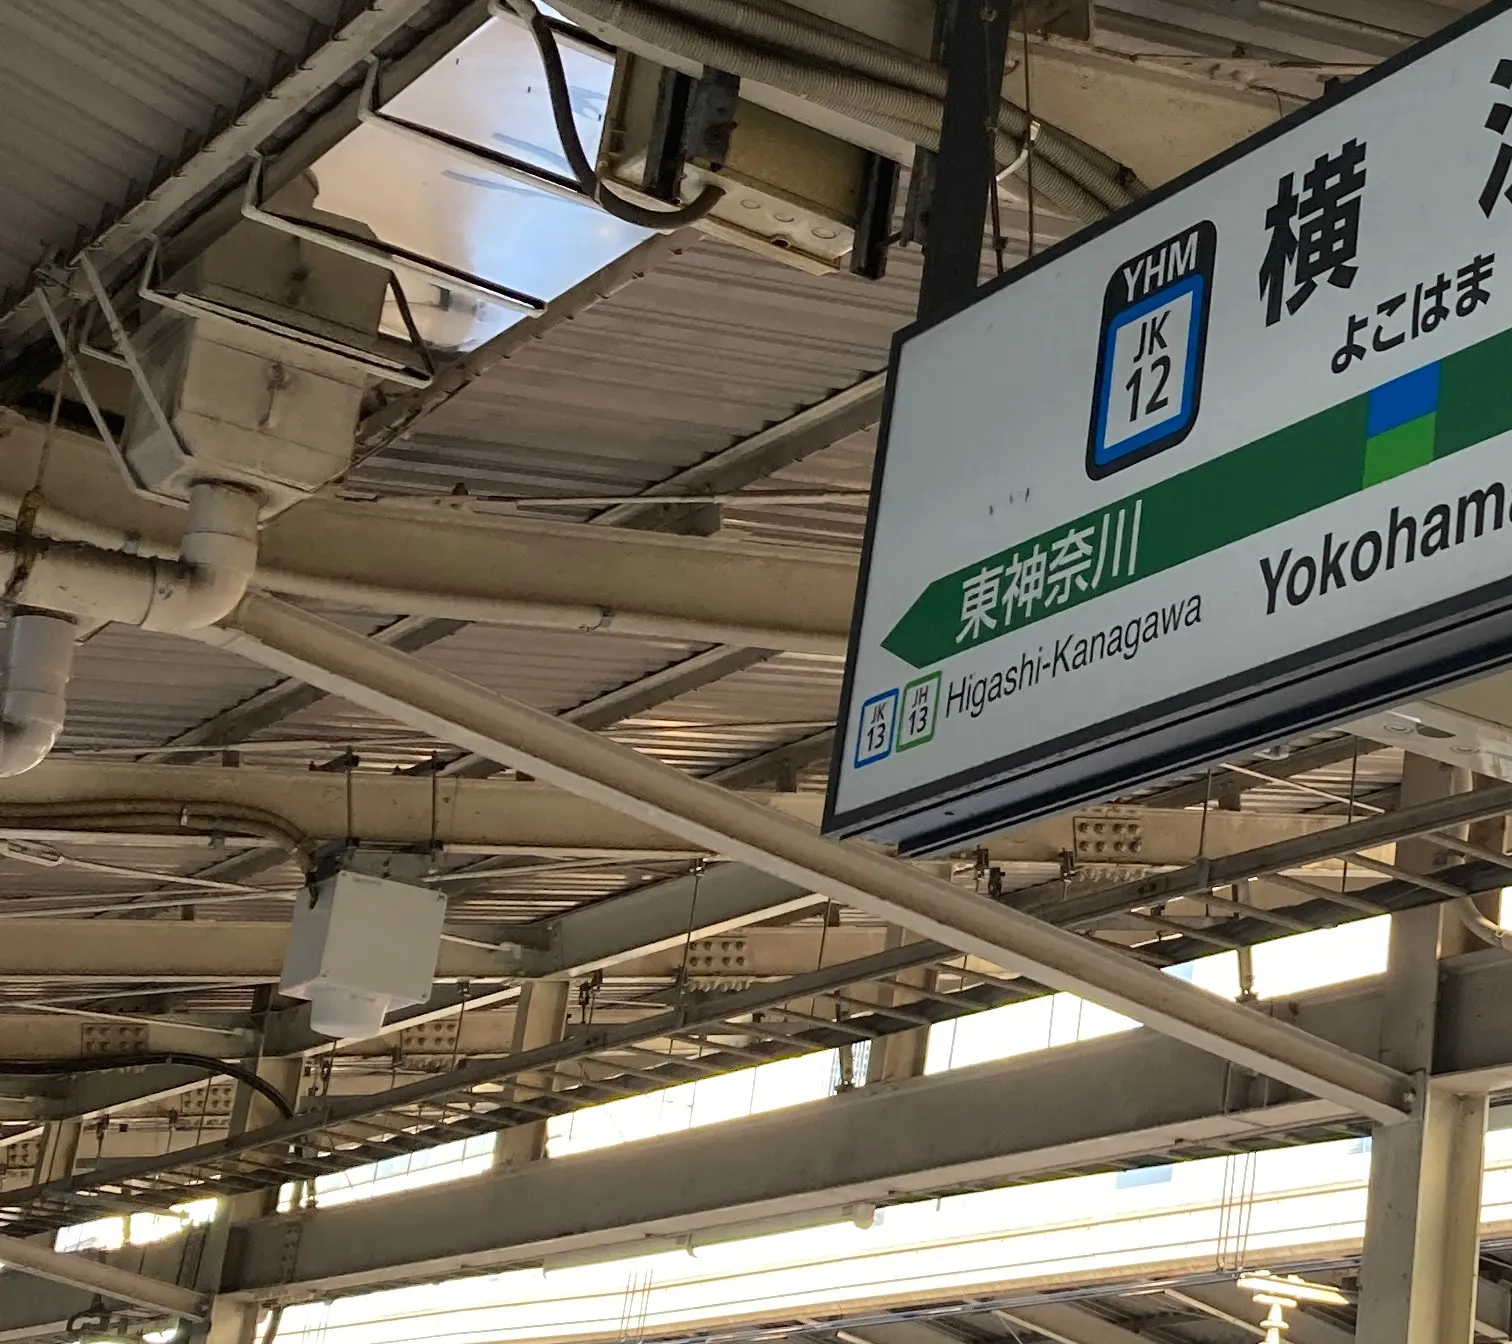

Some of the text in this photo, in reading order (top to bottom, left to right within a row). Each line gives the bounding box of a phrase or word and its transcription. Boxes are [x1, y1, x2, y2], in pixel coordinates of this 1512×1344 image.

[1123, 232, 1198, 303] YHM
[1133, 311, 1169, 364] JK
[1330, 253, 1496, 374] よこはま
[1125, 355, 1169, 423] 12
[956, 500, 1143, 644] 東神奈川
[945, 593, 1201, 719] Higashi-Kanagawa
[870, 703, 886, 724] JK
[908, 705, 928, 735] 13
[912, 687, 928, 706] JH
[866, 722, 885, 751] 13
